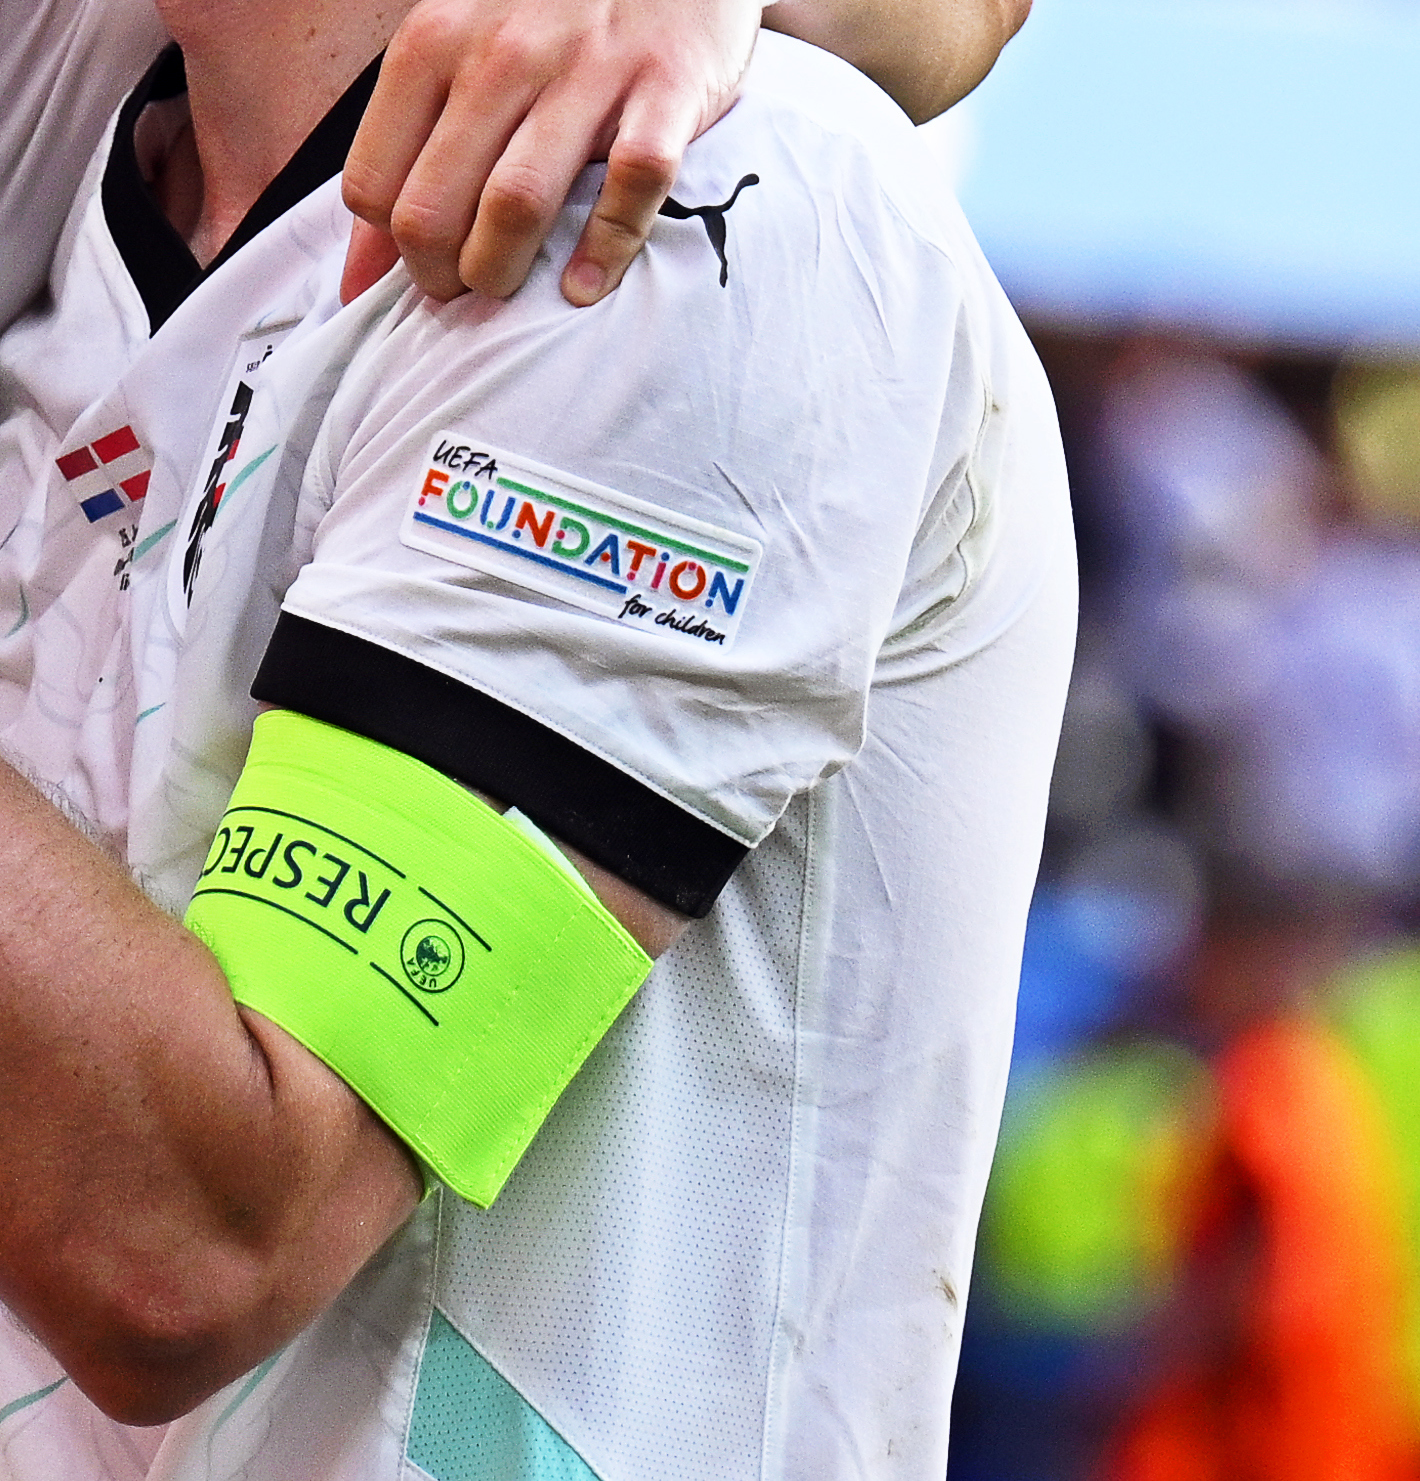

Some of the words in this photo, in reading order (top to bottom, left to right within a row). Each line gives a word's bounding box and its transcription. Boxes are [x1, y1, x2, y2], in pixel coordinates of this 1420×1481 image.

[433, 439, 498, 480] UEFA
[418, 468, 744, 615] FOUNDATION
[618, 593, 652, 619] for
[655, 608, 725, 645] children
[198, 825, 391, 933] RESPEC
[407, 956, 437, 988] UEFA
